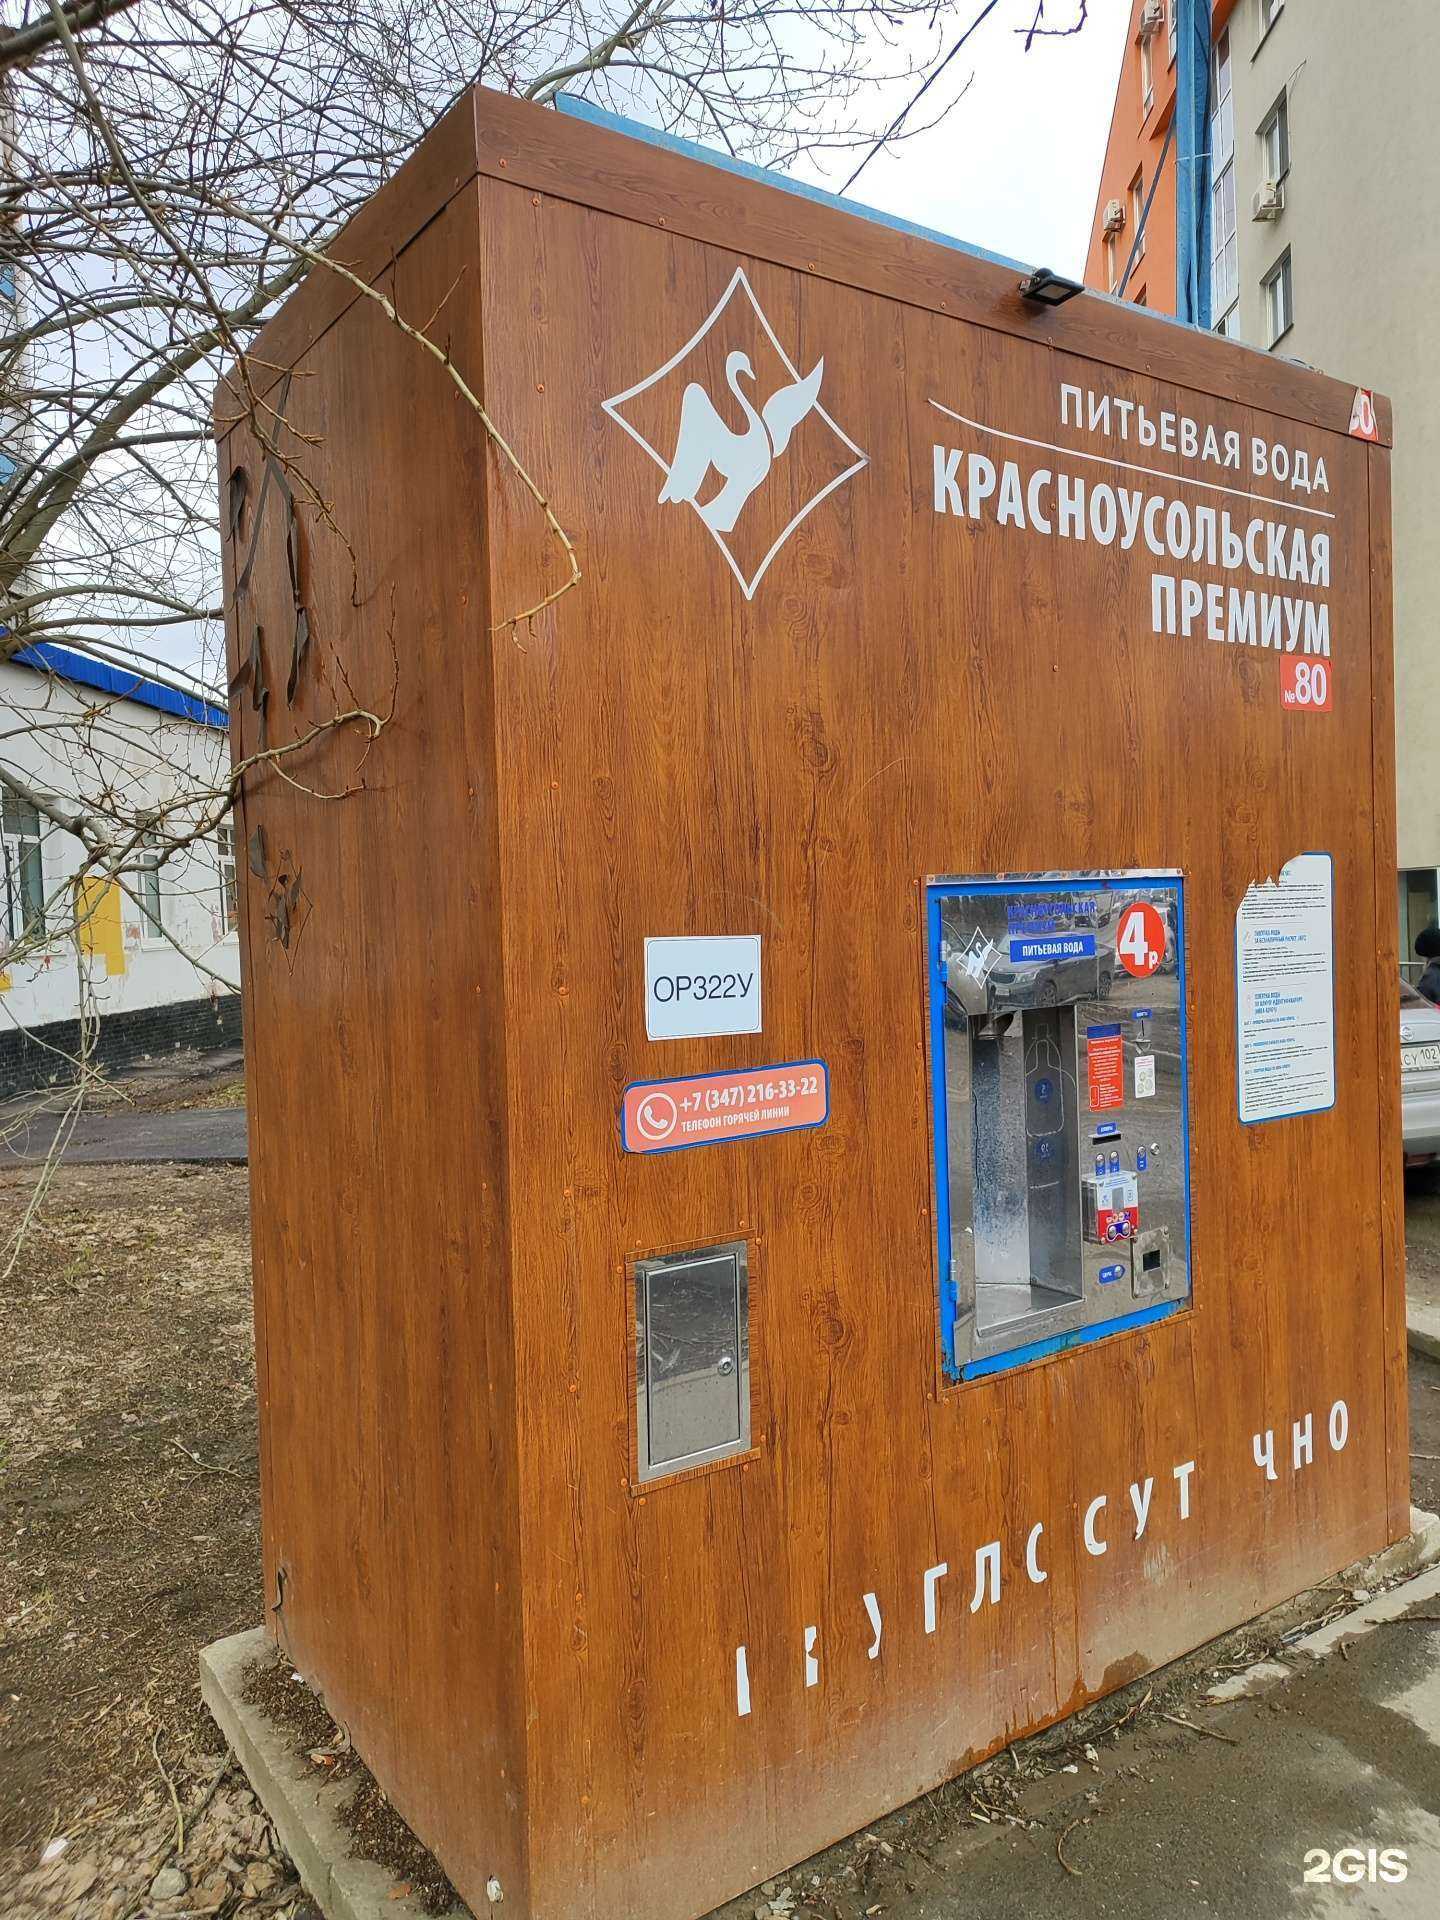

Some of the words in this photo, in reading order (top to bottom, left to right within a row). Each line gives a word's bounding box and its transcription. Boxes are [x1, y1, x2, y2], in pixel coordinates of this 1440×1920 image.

[1060, 382, 1240, 470] ПИТЬЕВАЯ
[1251, 437, 1330, 494] ВОДА
[932, 444, 1330, 588] КРАСНОУСОЛЬСКАЯ
[1151, 573, 1331, 657] ПРЕМИУМ
[1022, 943, 1062, 957] ПИТЬЕВАЯ
[1063, 941, 1084, 954] ВОДА
[680, 1091, 702, 1113] +7
[705, 1086, 745, 1112] (347)
[747, 1076, 818, 1103] 216-33-22
[681, 1116, 721, 1133] ТЕЛЕФОН
[723, 1109, 760, 1127] ГОРЯЧЕЙ
[761, 1105, 790, 1121] ЛИНИИ
